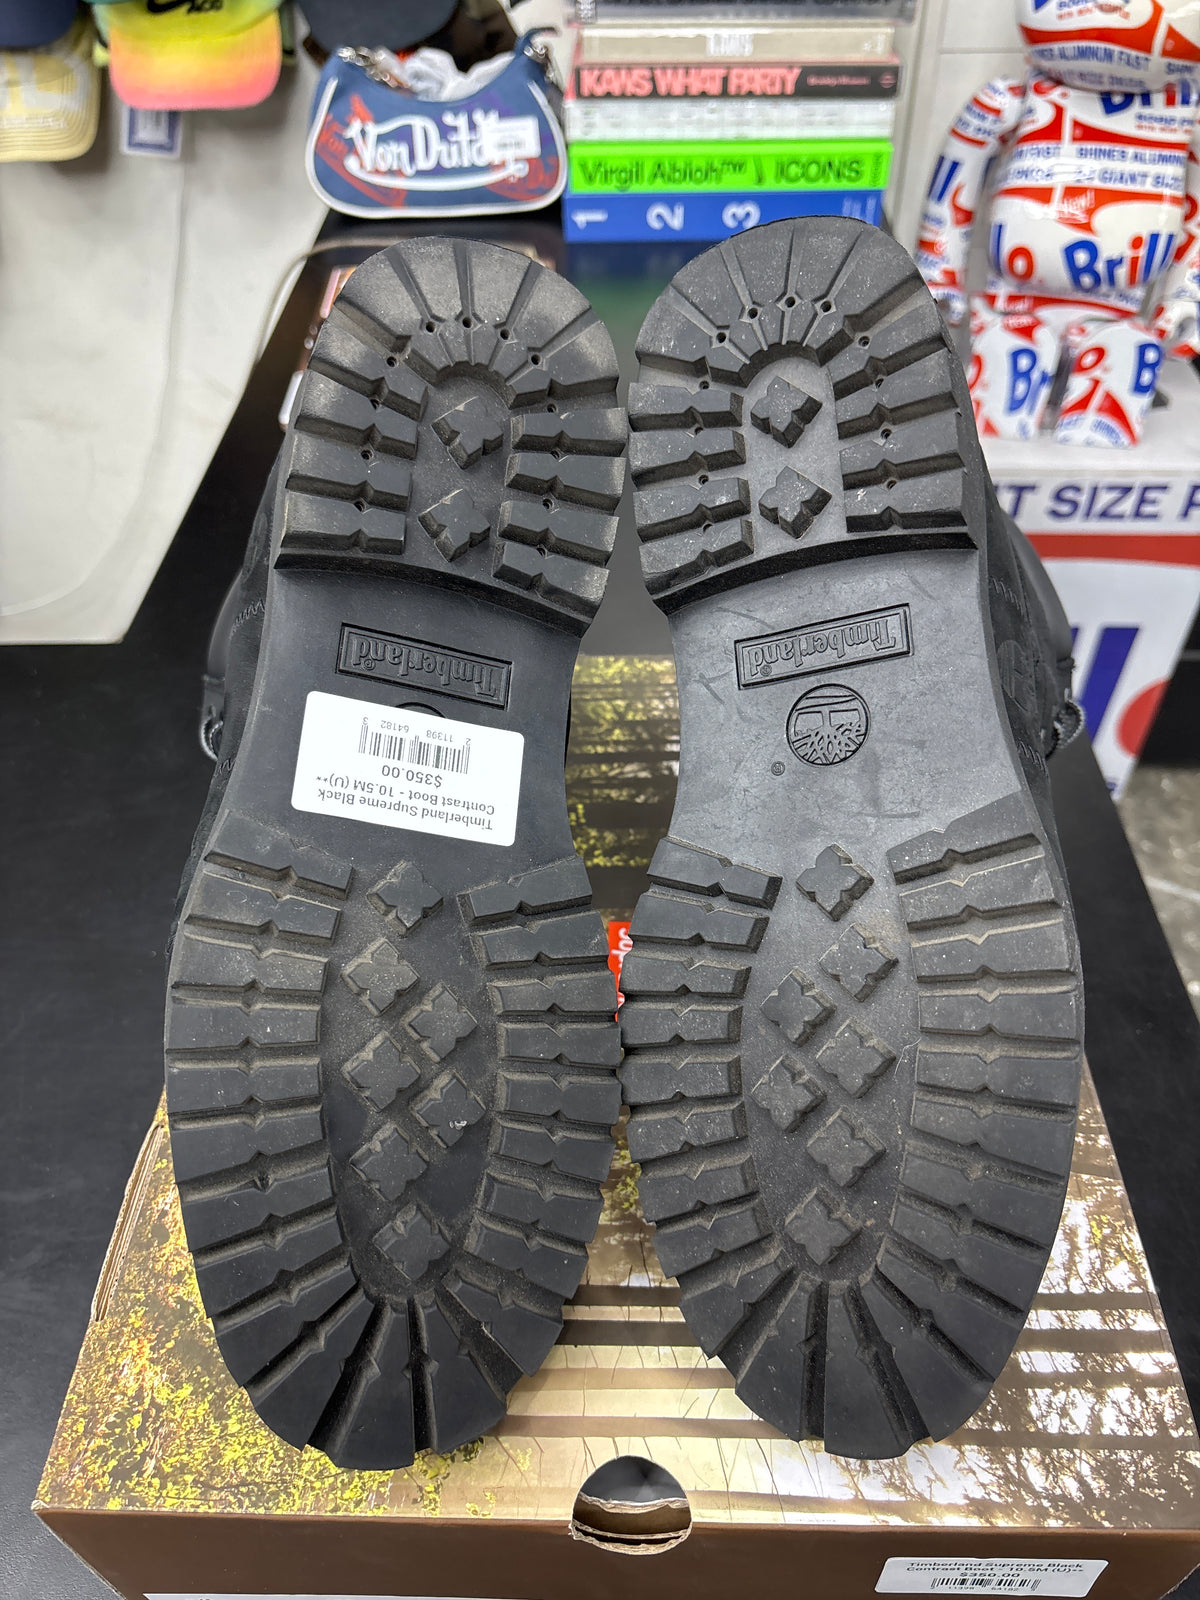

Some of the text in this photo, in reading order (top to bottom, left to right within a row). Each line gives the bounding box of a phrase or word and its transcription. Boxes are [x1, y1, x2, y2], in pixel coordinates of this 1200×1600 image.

[653, 67, 728, 96] WHAT
[727, 67, 802, 96] PARTY
[577, 159, 645, 192] Virgil
[774, 159, 864, 184] ICONS
[571, 208, 609, 230] 1
[646, 201, 685, 231] 2
[722, 201, 761, 230] 3
[1048, 483, 1168, 519] SIZE
[380, 719, 410, 734] 64182
[426, 729, 453, 743] 11398
[353, 779, 394, 798] 10.5M
[381, 764, 443, 789] $350.00
[317, 788, 493, 830] Timberland Supreme Black
[408, 790, 438, 806] Boot
[441, 796, 495, 815] Contrast
